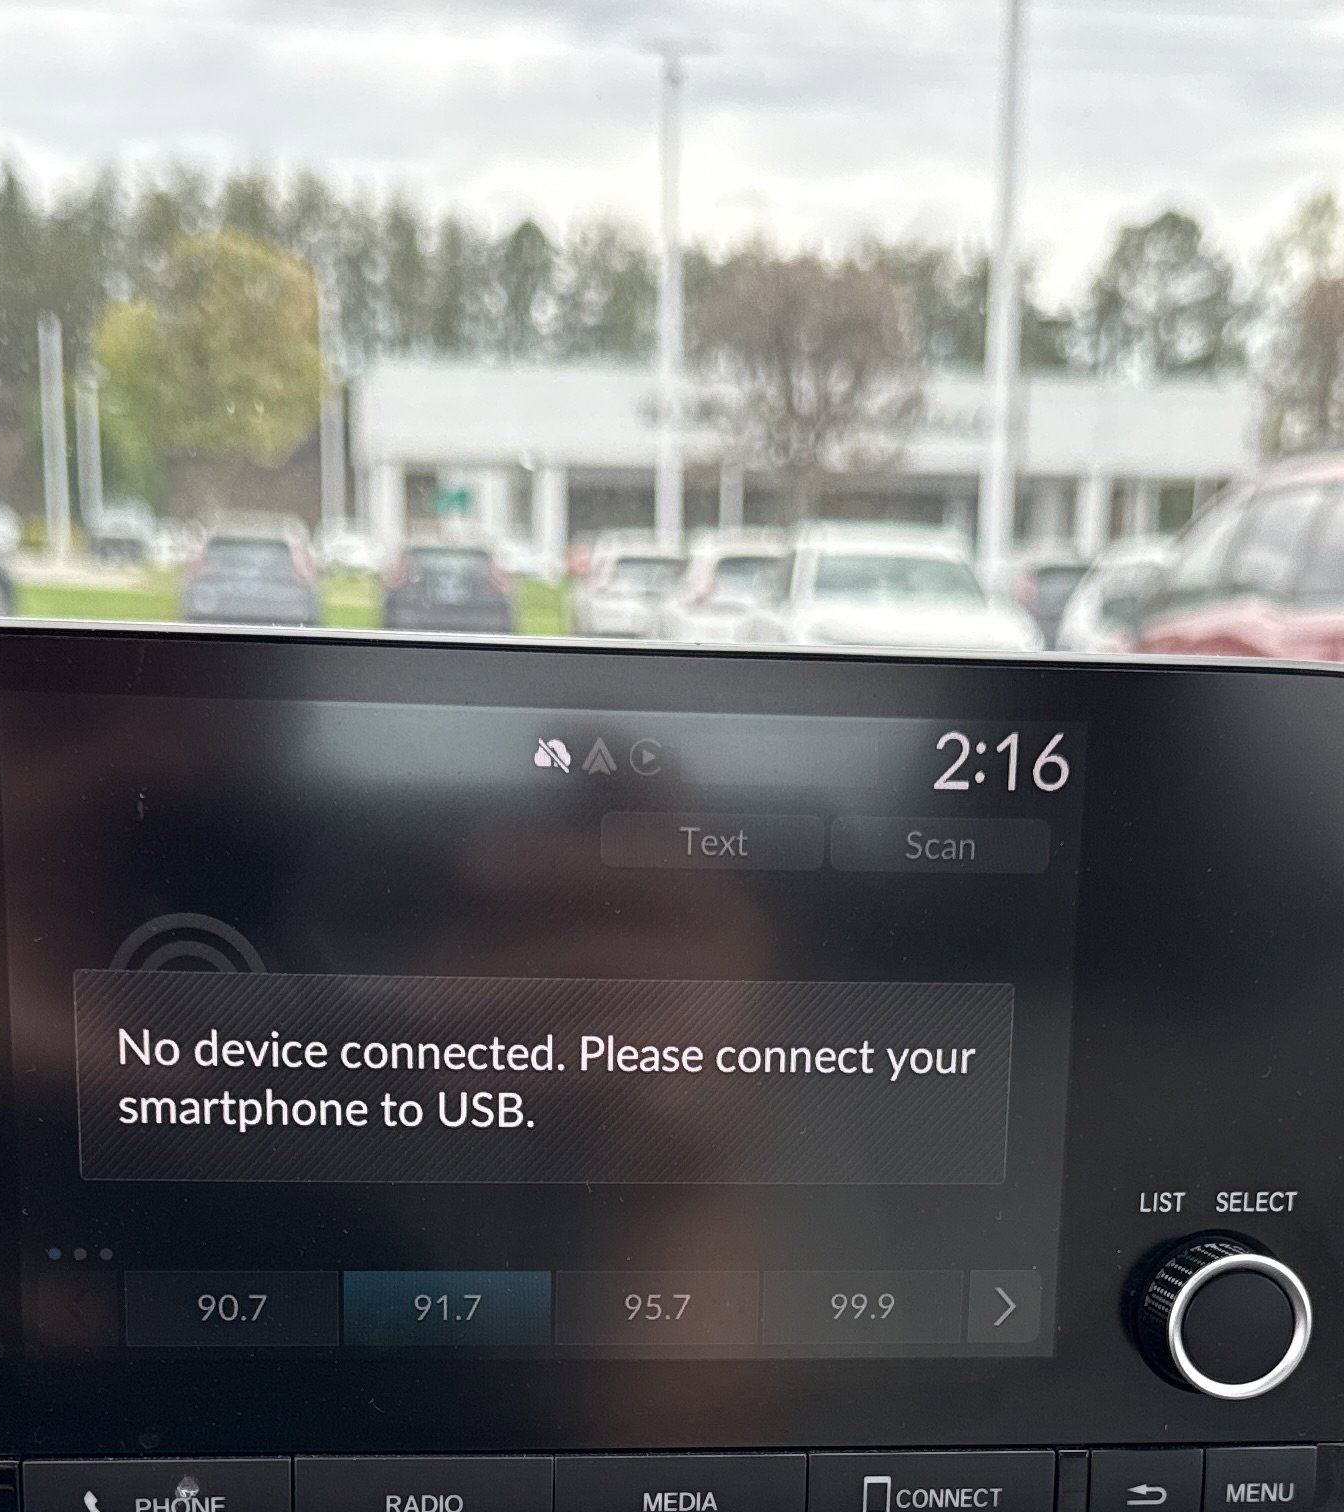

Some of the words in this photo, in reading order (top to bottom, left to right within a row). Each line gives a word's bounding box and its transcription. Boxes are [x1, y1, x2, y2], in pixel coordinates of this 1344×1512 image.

[933, 731, 1070, 791] 2:16
[679, 827, 748, 857] Text
[905, 831, 976, 860] Scan
[118, 1028, 180, 1066] No
[194, 1030, 328, 1068] device
[341, 1034, 565, 1072] connected.
[580, 1035, 703, 1073] Please
[716, 1040, 874, 1075] connect
[887, 1046, 976, 1081] your
[118, 1088, 369, 1132] smartphone
[381, 1094, 424, 1127] to
[439, 1092, 535, 1128] USB.
[1139, 1192, 1186, 1214] LIST
[1215, 1191, 1298, 1213] SELECT
[198, 1293, 268, 1321] 90.7
[414, 1293, 482, 1321] 91.7
[624, 1293, 692, 1321] 95.7
[830, 1292, 896, 1320] 99.9
[642, 1491, 719, 1512] MEDIA
[896, 1486, 1003, 1509] CONNECT
[1225, 1481, 1295, 1504] MENU
